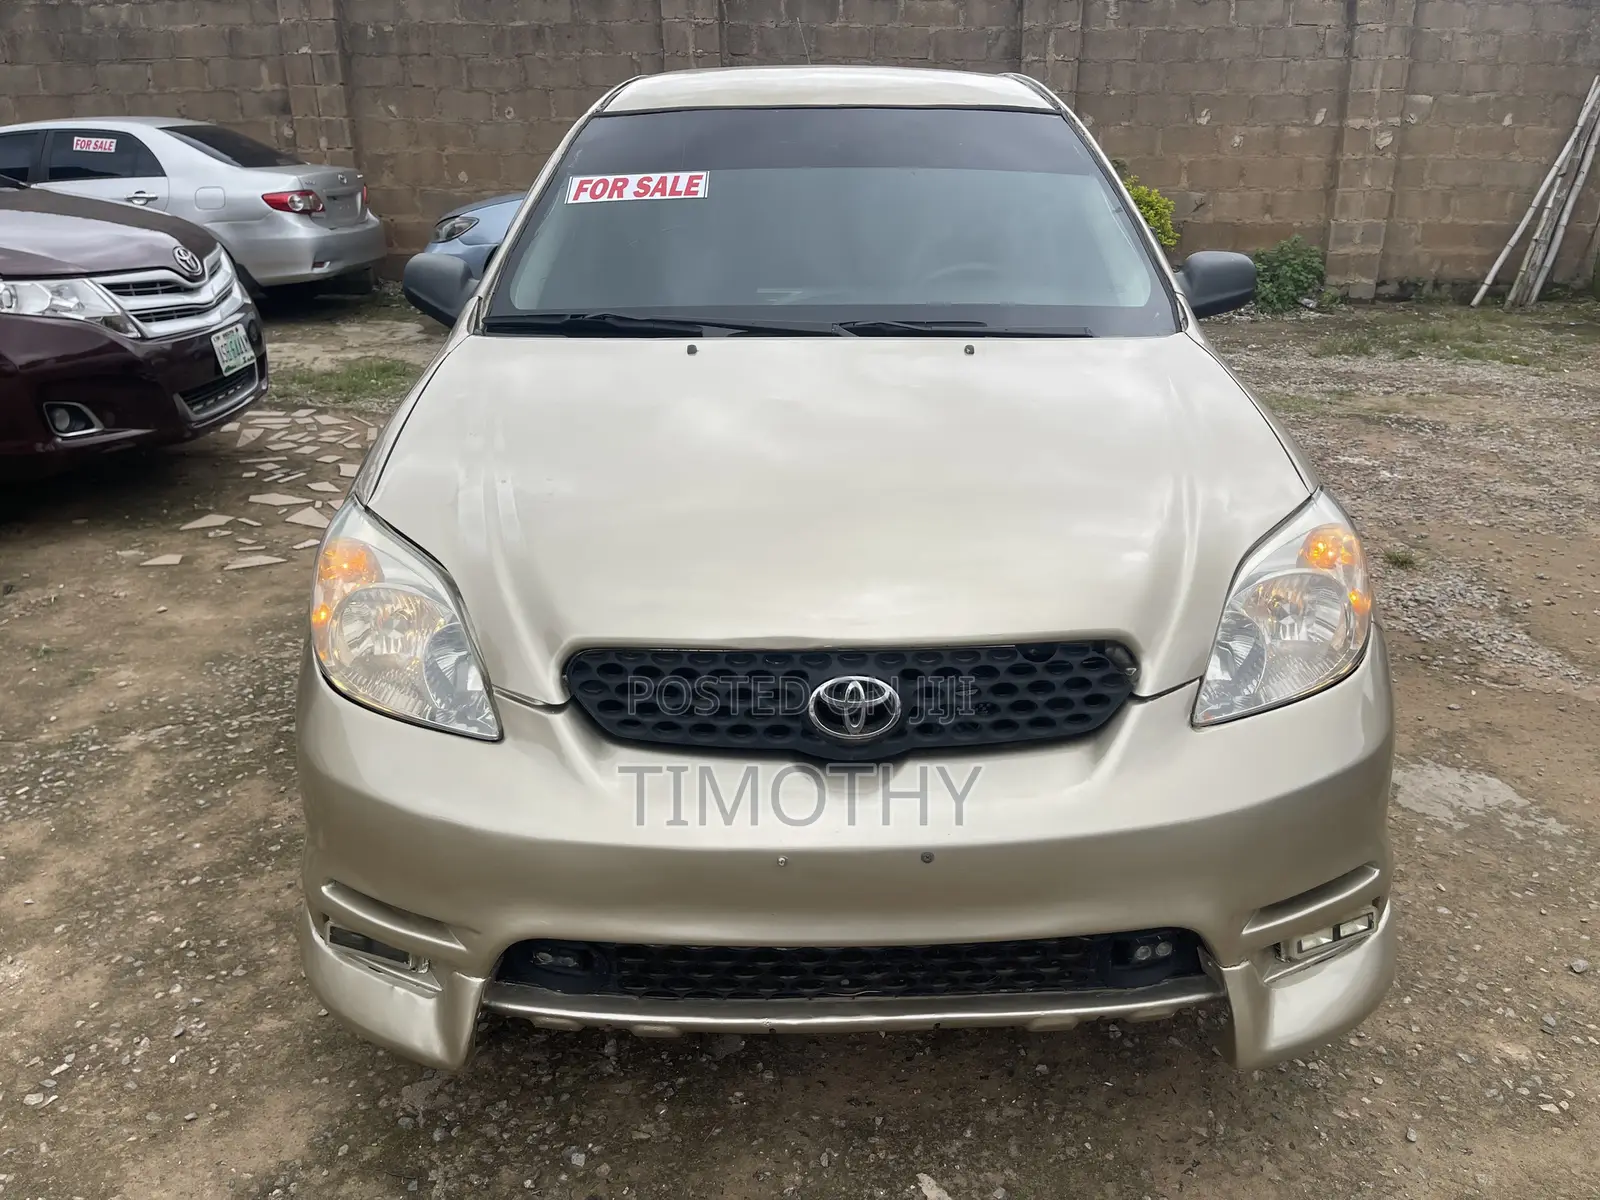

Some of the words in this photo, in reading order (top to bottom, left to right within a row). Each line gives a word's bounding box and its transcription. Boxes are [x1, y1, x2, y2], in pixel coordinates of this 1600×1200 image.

[75, 139, 92, 150] FOR
[93, 140, 114, 151] SALE
[572, 177, 629, 201] FOR
[633, 174, 704, 198] SALE
